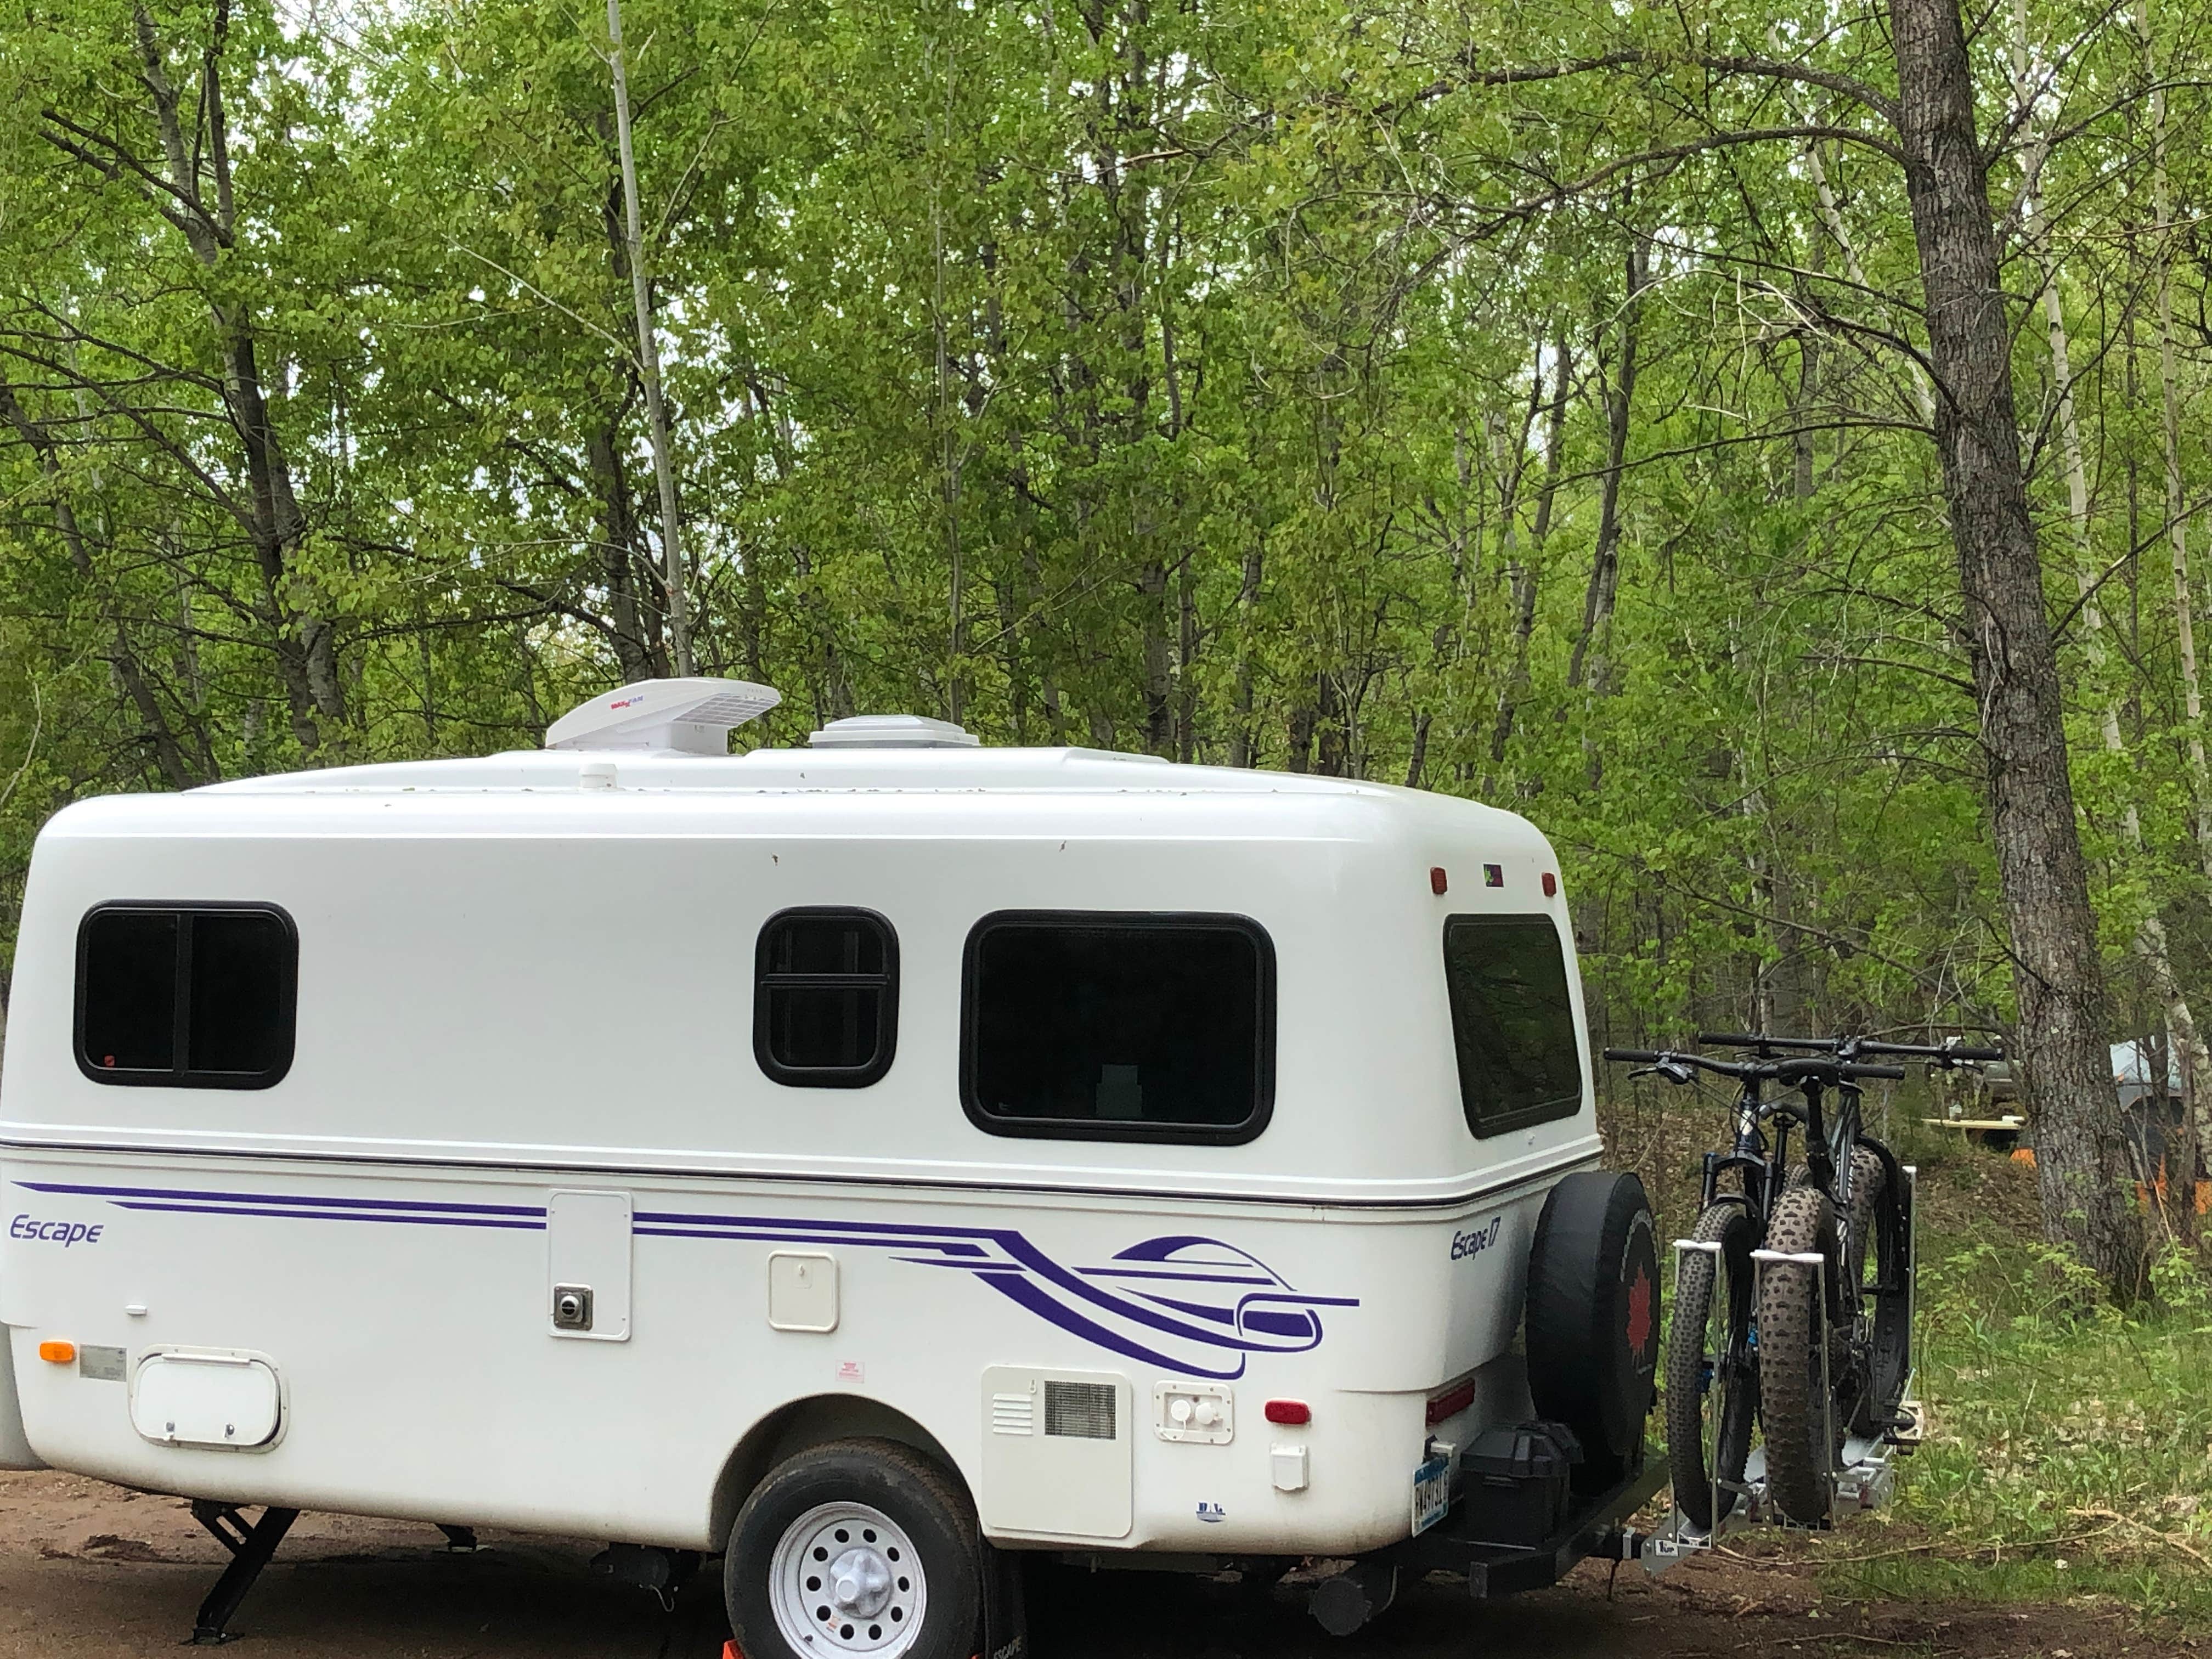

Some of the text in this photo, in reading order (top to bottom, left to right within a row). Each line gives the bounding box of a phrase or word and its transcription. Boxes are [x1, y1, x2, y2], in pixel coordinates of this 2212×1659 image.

[10, 1214, 104, 1248] Escape
[1450, 1216, 1501, 1261] Escape 17
